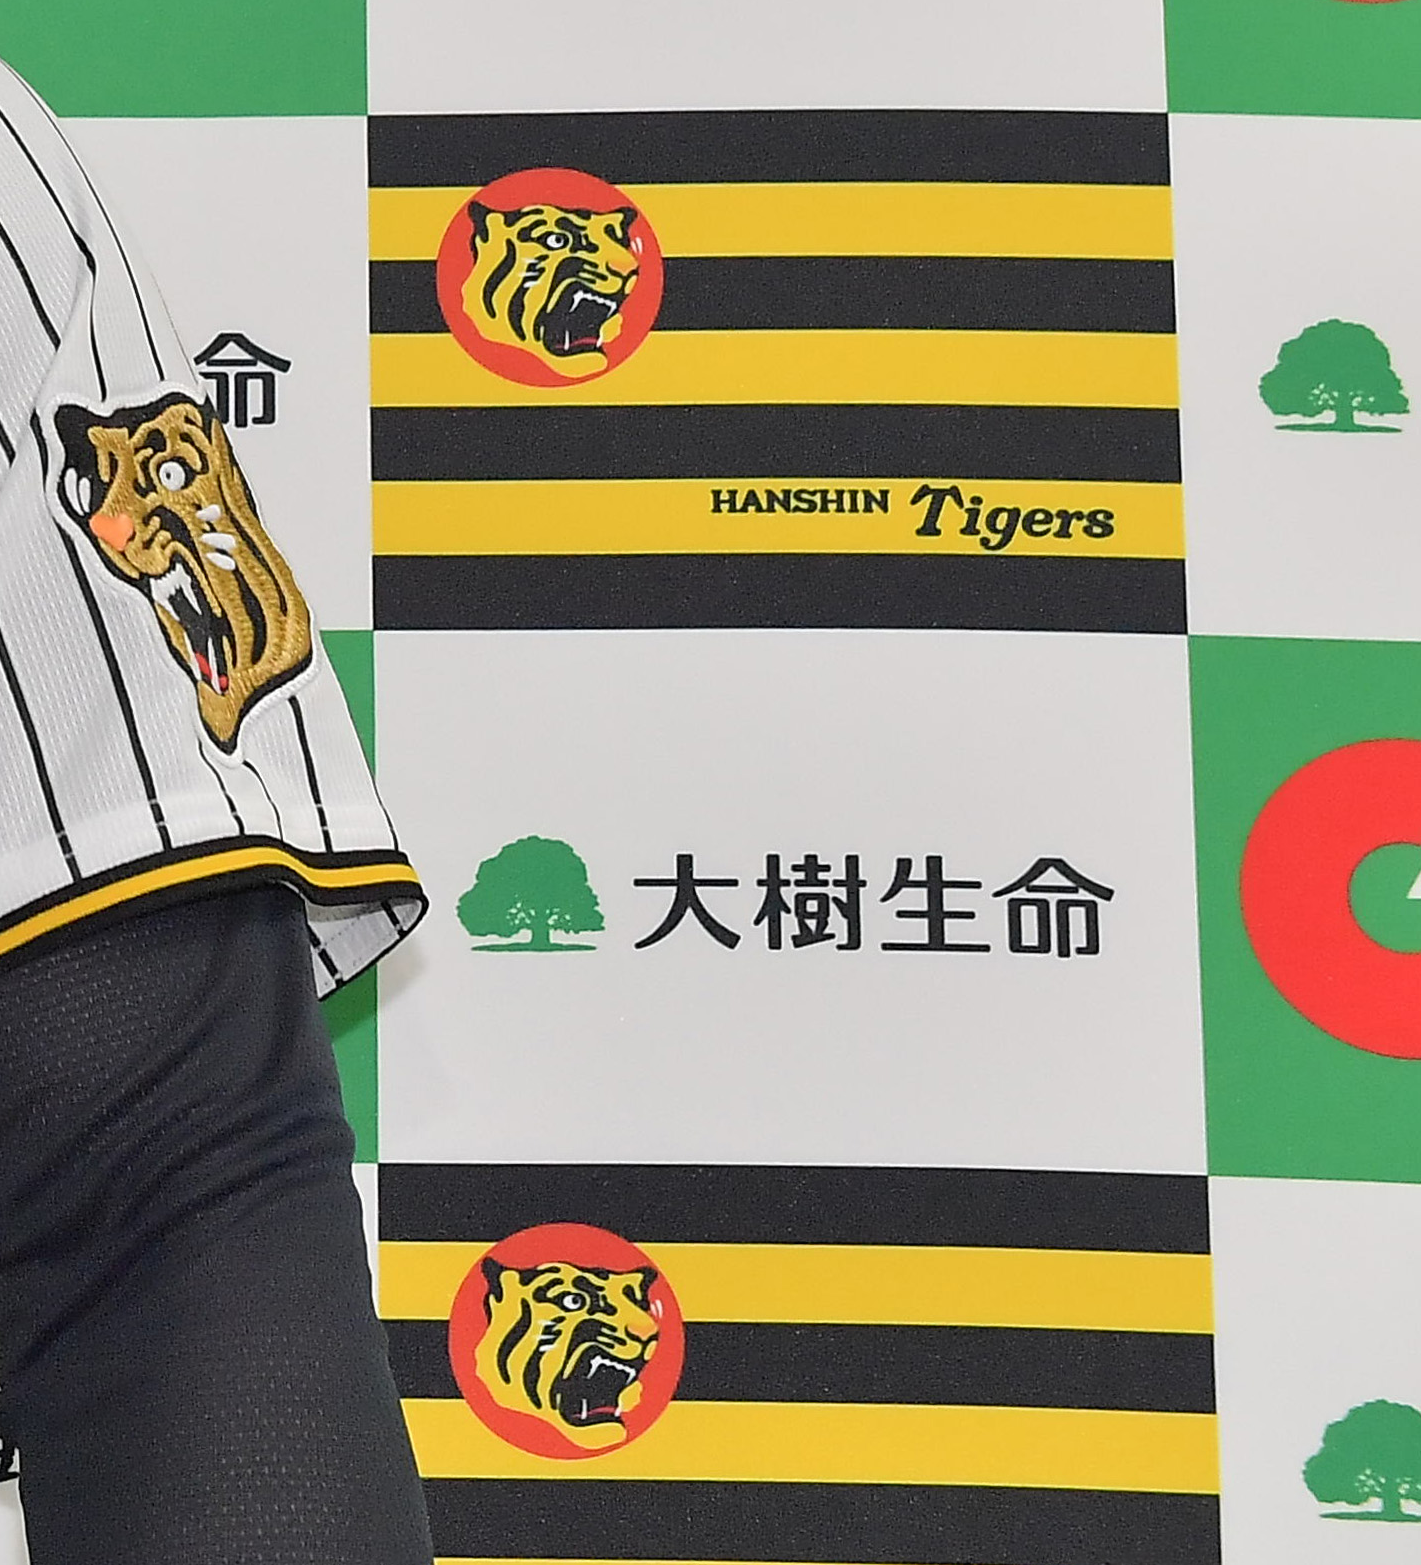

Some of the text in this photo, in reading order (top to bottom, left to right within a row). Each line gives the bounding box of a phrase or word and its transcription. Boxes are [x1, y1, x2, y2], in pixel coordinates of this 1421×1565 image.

[710, 483, 1116, 552] HANSHIN Tigers
[632, 853, 1116, 959] 大樹生命
